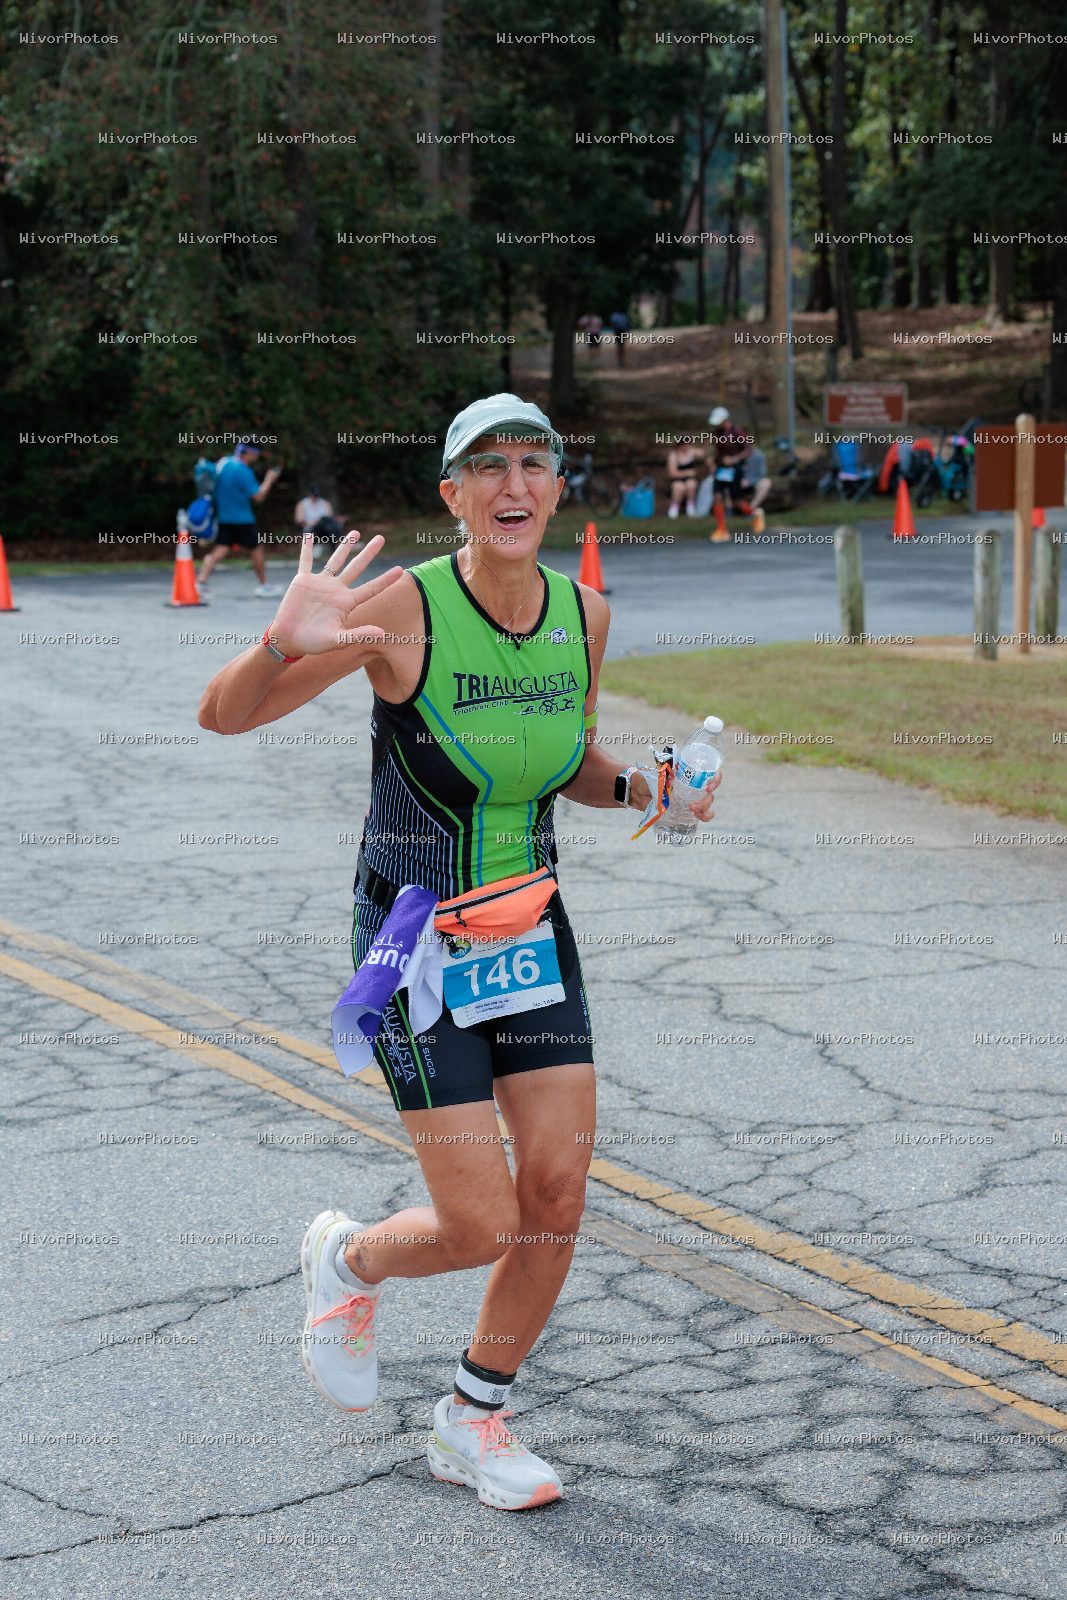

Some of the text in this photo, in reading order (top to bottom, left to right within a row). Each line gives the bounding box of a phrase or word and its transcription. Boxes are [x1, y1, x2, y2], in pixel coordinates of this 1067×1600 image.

[491, 700, 509, 708] Club
[463, 948, 541, 997] 146
[384, 999, 417, 1085] AUGUSTA
